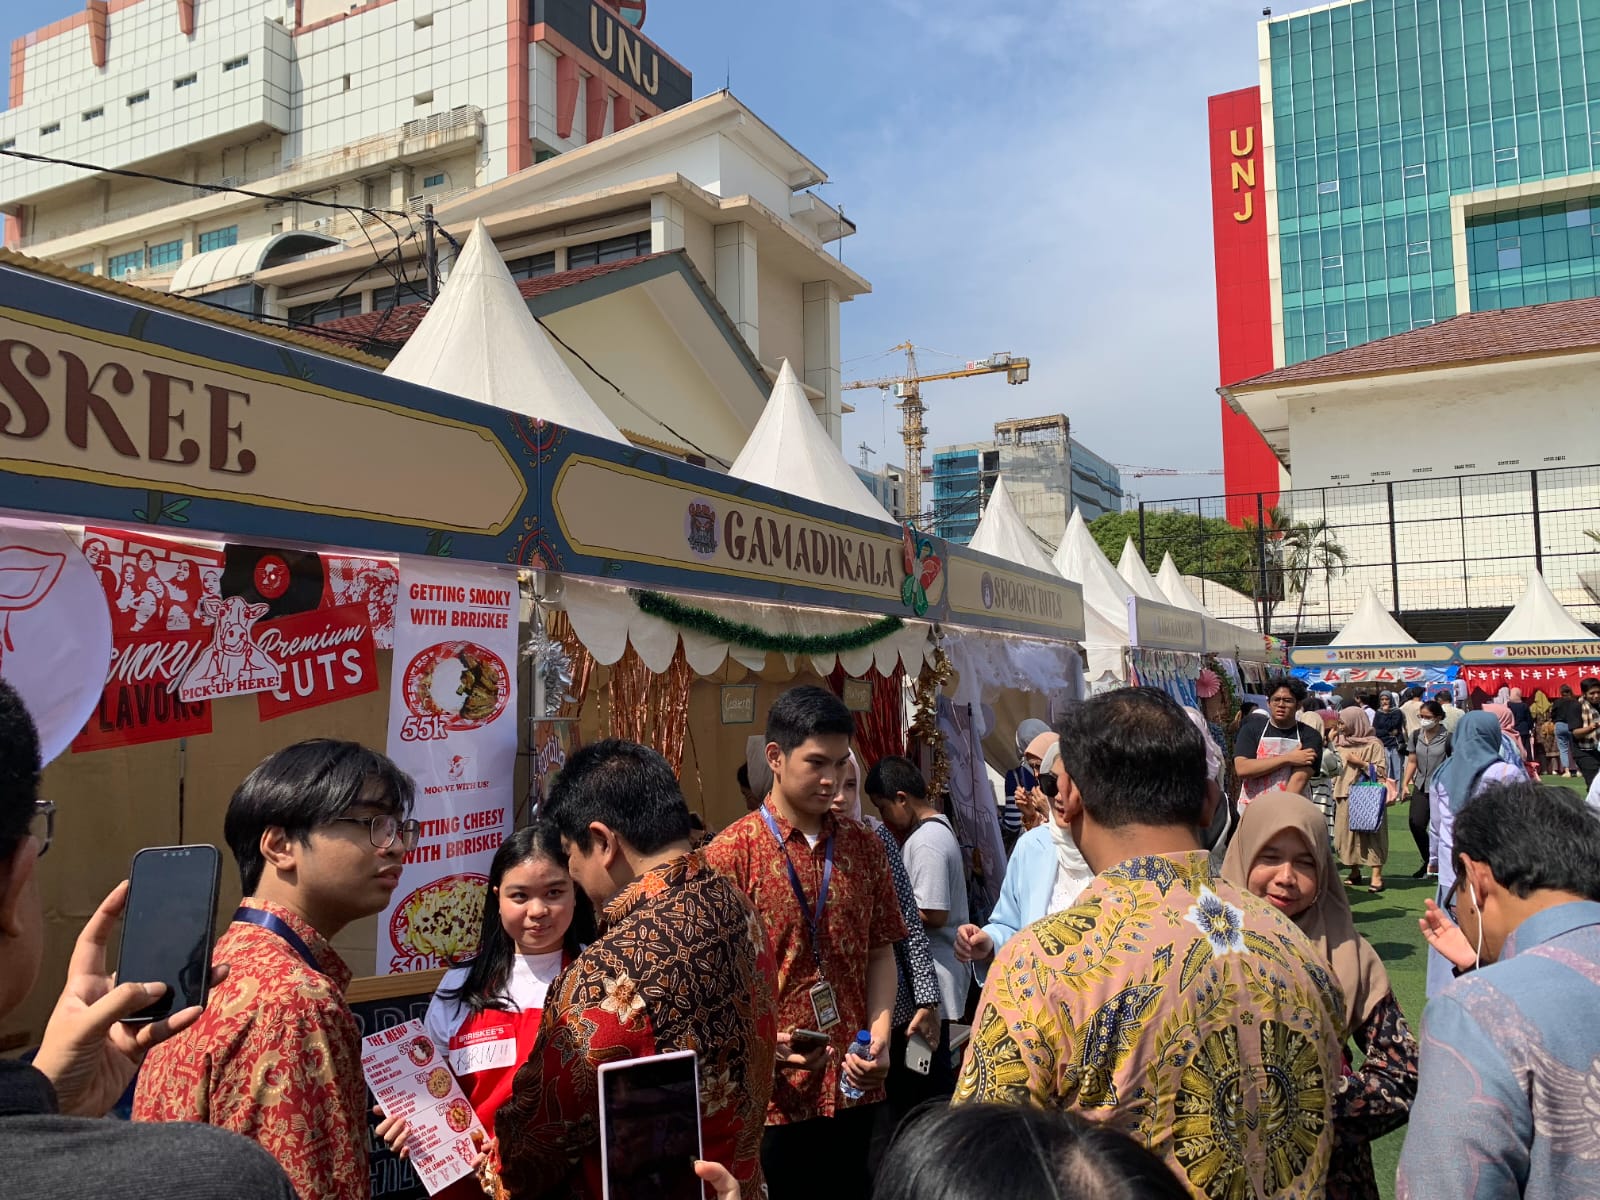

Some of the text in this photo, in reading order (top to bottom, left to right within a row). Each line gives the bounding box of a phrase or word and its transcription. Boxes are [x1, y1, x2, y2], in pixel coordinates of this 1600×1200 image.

[590, 4, 659, 96] UNJ
[1229, 126, 1256, 222] UNJ
[0, 338, 257, 475] SKEE
[723, 510, 896, 589] GAMADIKALA
[409, 583, 511, 606] GETTING SMOKY
[993, 576, 1037, 616] SPOOKY
[410, 607, 509, 629] WITH BRRISKEE
[258, 623, 367, 658] Premium
[1338, 648, 1417, 660] MUSHI MUSHI
[105, 640, 202, 694] MOKY
[274, 647, 364, 702] CUTS
[237, 676, 280, 691] HERE!
[400, 715, 449, 742] 55k
[424, 780, 490, 795] MOO-VE WITH US!
[418, 807, 505, 838] TTING CHEESY
[402, 832, 503, 864] WITH BRRISKEE
[366, 1024, 408, 1047] THE MENU
